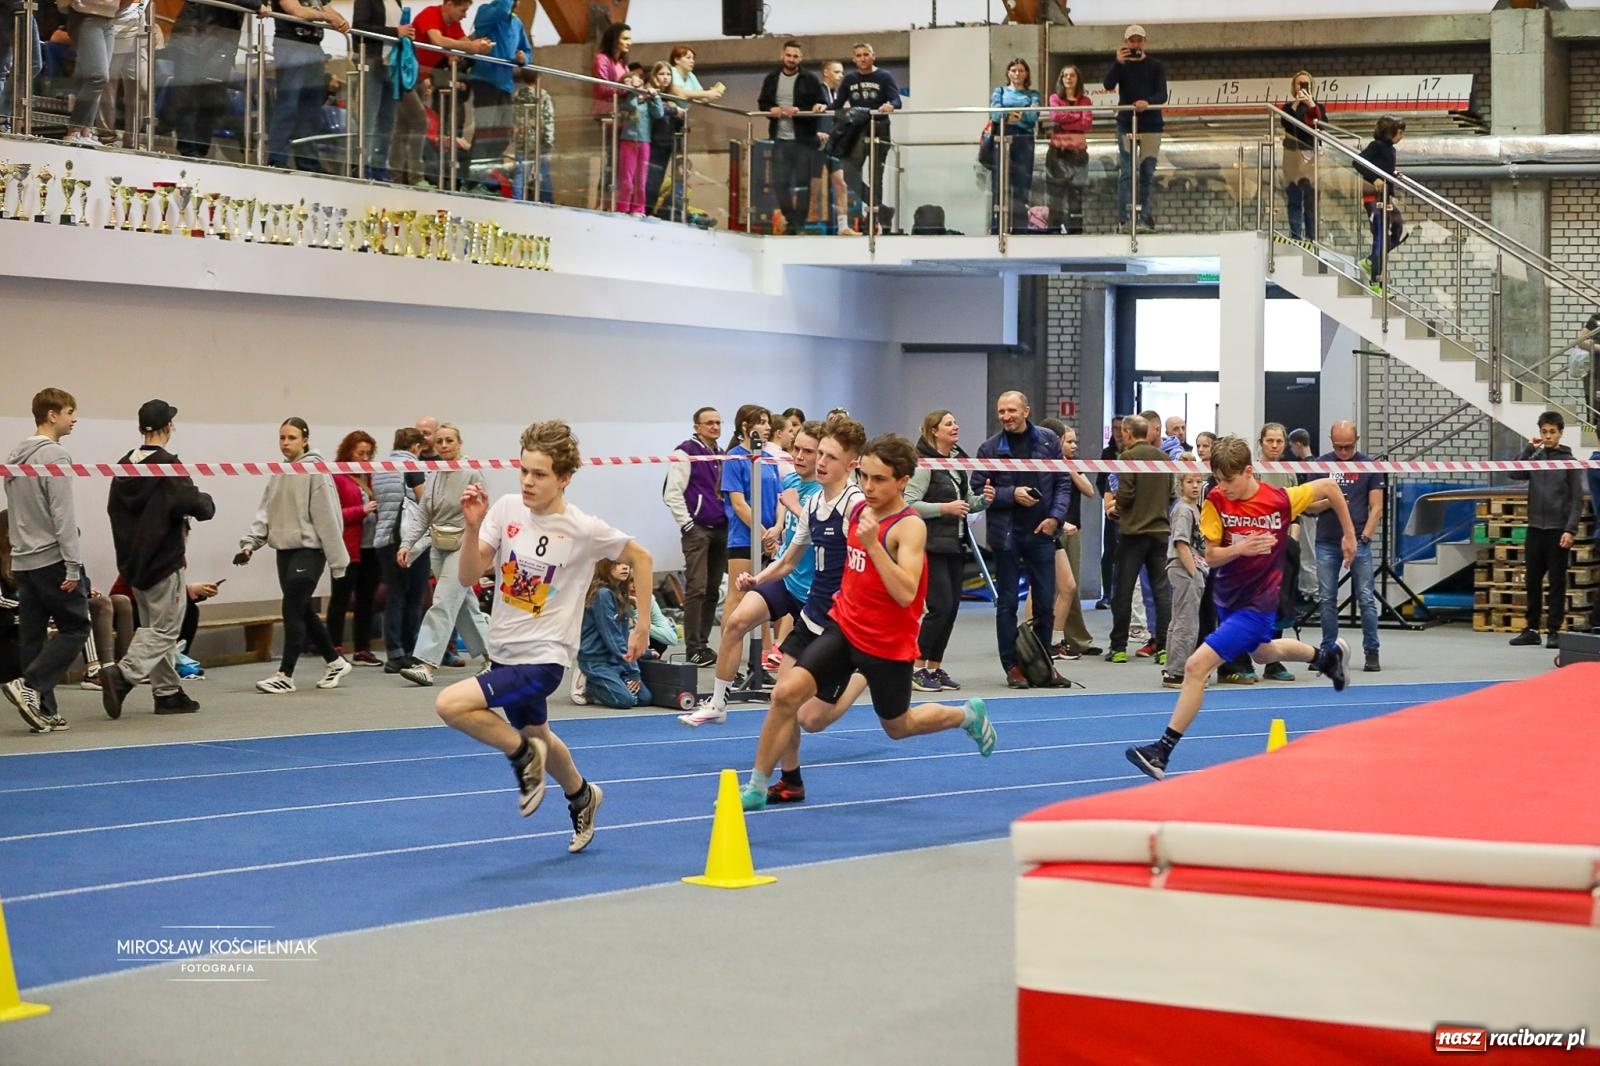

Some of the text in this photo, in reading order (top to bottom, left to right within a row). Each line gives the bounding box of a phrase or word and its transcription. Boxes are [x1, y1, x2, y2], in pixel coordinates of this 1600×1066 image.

[1221, 81, 1240, 95] 15
[1321, 79, 1340, 93] 16
[1421, 77, 1442, 91] 17
[535, 535, 549, 557] 8
